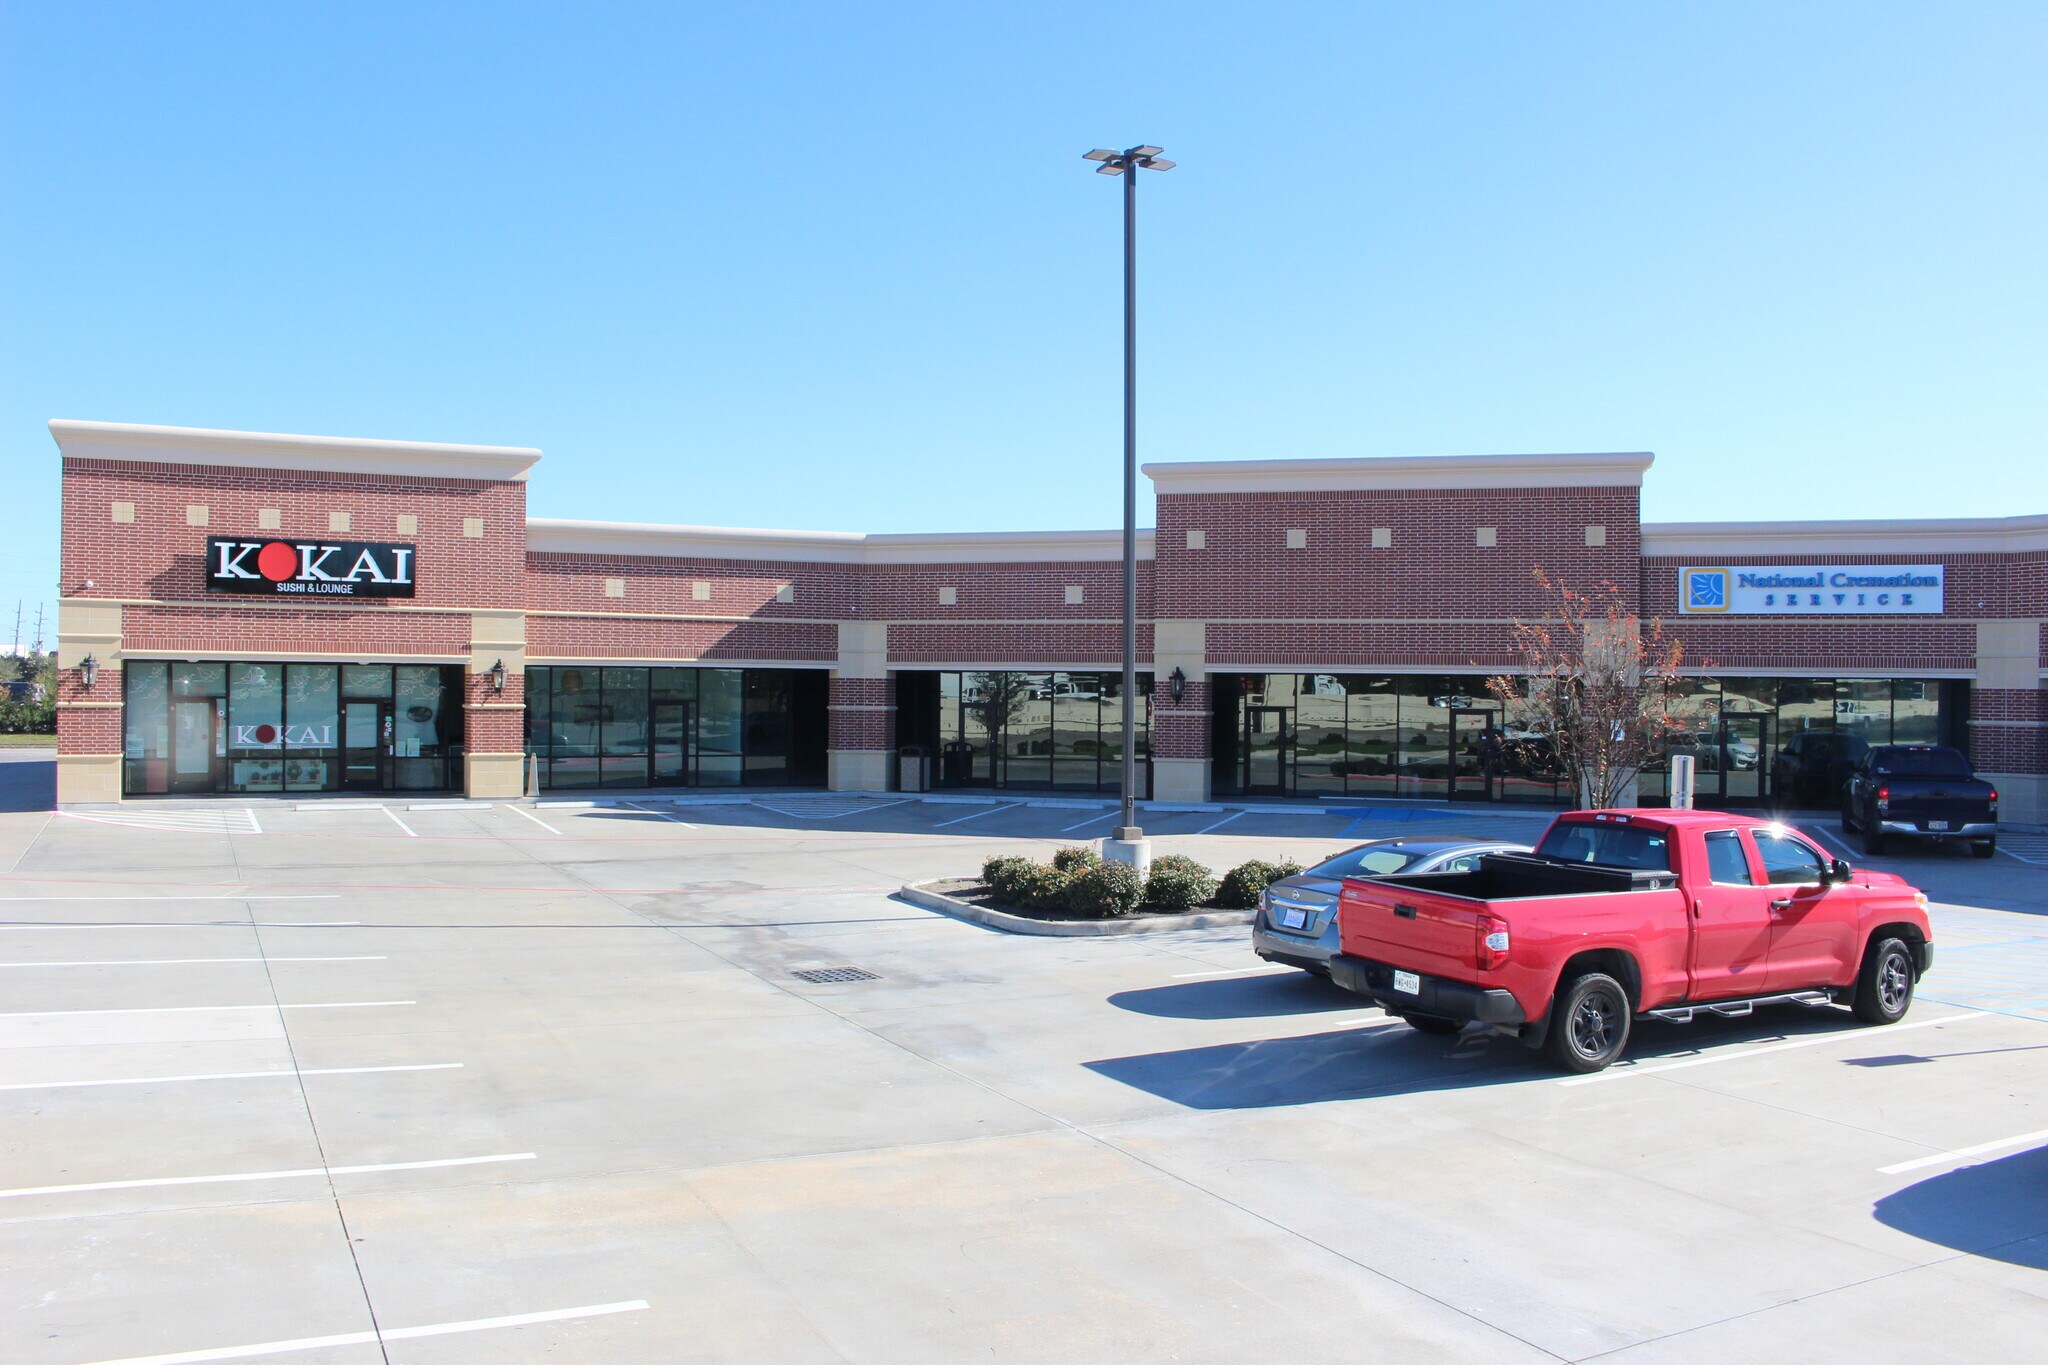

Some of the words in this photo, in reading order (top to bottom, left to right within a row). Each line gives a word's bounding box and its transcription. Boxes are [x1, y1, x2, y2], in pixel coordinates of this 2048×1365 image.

[214, 541, 412, 584] KOKAI
[277, 582, 306, 593] SUSHI
[307, 583, 315, 593] &
[316, 583, 353, 594] LOUNGE
[1738, 572, 1824, 588] National
[1830, 572, 1939, 588] Cremation
[1765, 593, 1913, 606] SERVICE
[236, 724, 332, 744] KOKAI
